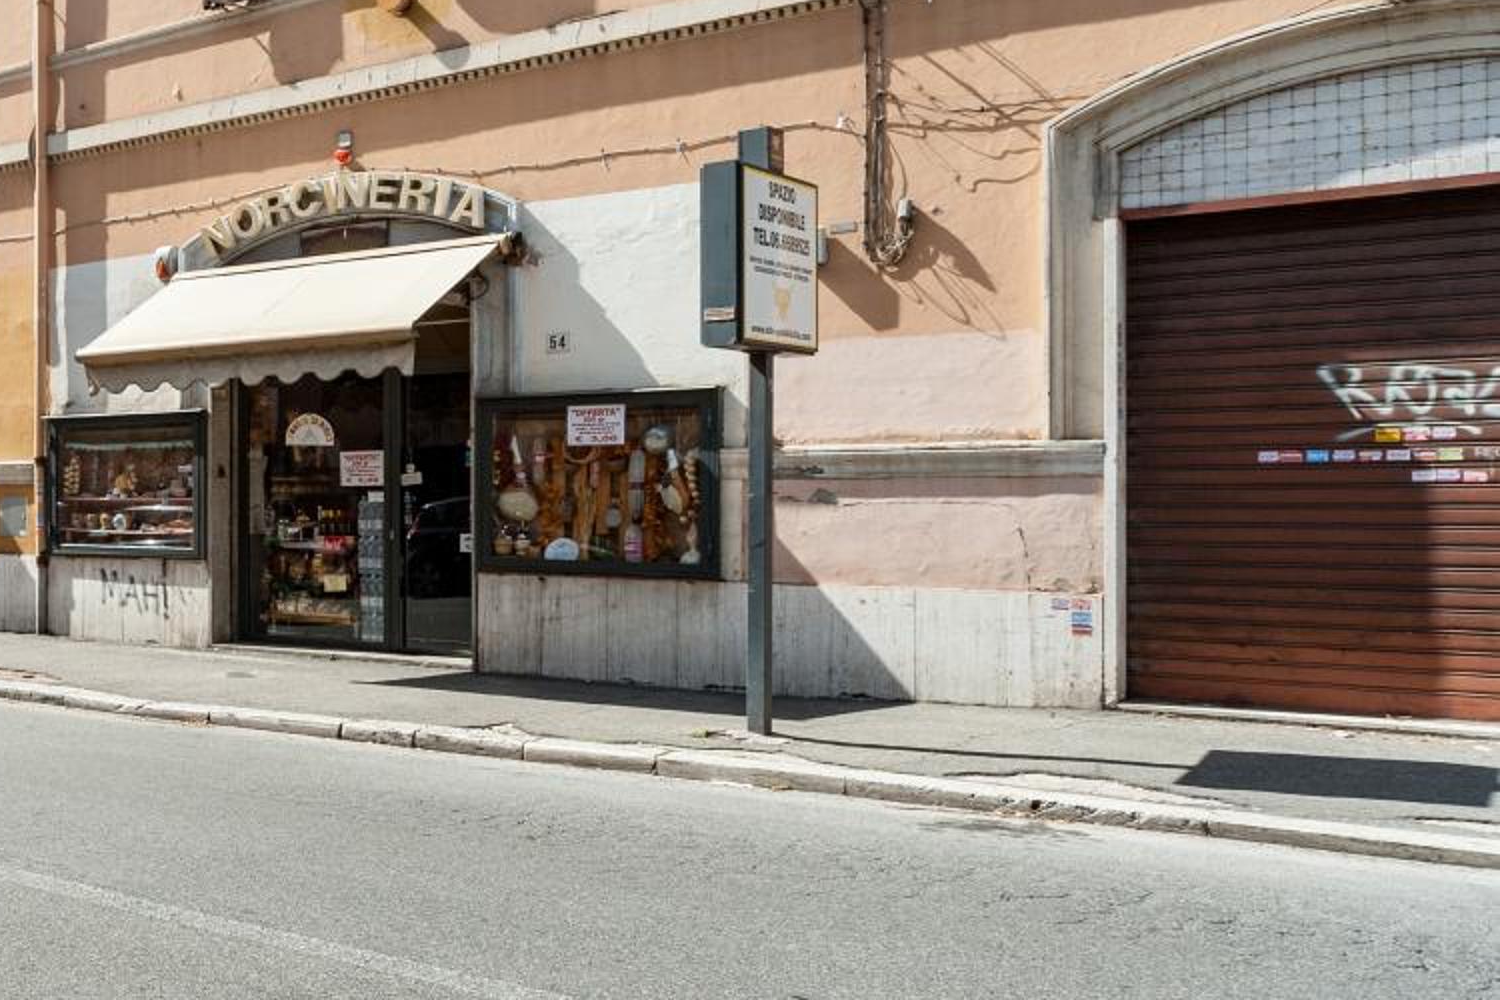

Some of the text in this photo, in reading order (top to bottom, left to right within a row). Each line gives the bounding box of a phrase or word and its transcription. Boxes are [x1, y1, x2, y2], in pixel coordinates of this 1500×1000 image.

[201, 173, 486, 256] NORCINERIA
[758, 203, 805, 231] DISPONIBILE
[549, 335, 566, 349] 54
